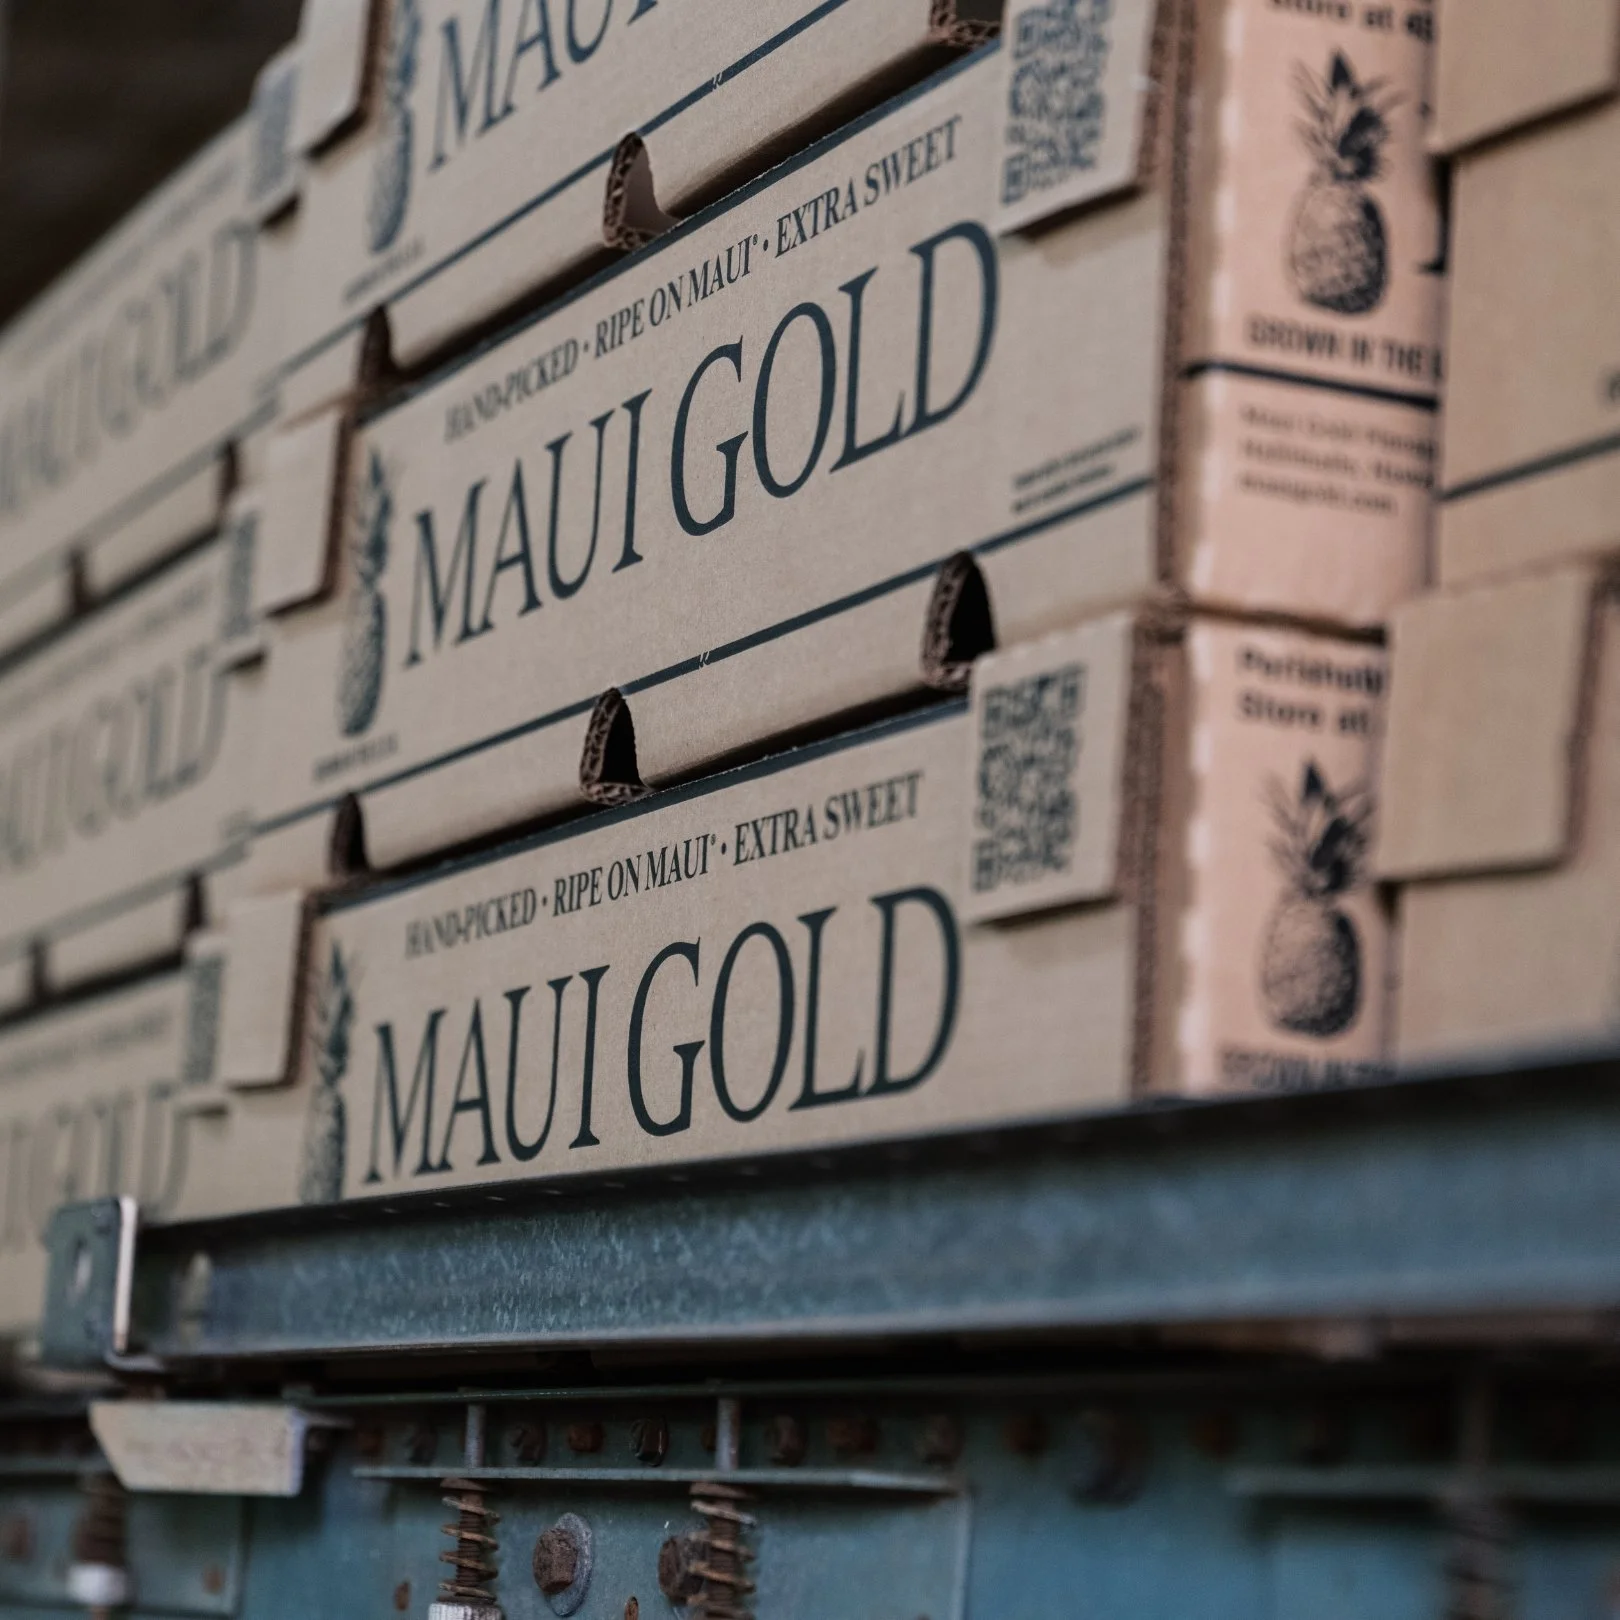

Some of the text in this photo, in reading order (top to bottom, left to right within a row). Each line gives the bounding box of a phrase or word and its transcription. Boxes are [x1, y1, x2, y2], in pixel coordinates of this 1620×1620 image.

[444, 337, 579, 444] HAND-PICKED
[593, 298, 645, 359] RIPE
[649, 275, 685, 327] ON
[774, 177, 858, 258] EXTRA
[863, 113, 962, 207] SWEET
[404, 387, 653, 669] MAUI
[671, 220, 999, 537] GOLD
[404, 888, 538, 960] HAND-PICKED
[553, 866, 604, 918] RIPE
[607, 854, 642, 901] ON
[733, 804, 818, 866] EXTRA
[822, 769, 925, 841] SWEET
[361, 964, 611, 1185] MAUI
[627, 885, 961, 1137] GOLD
